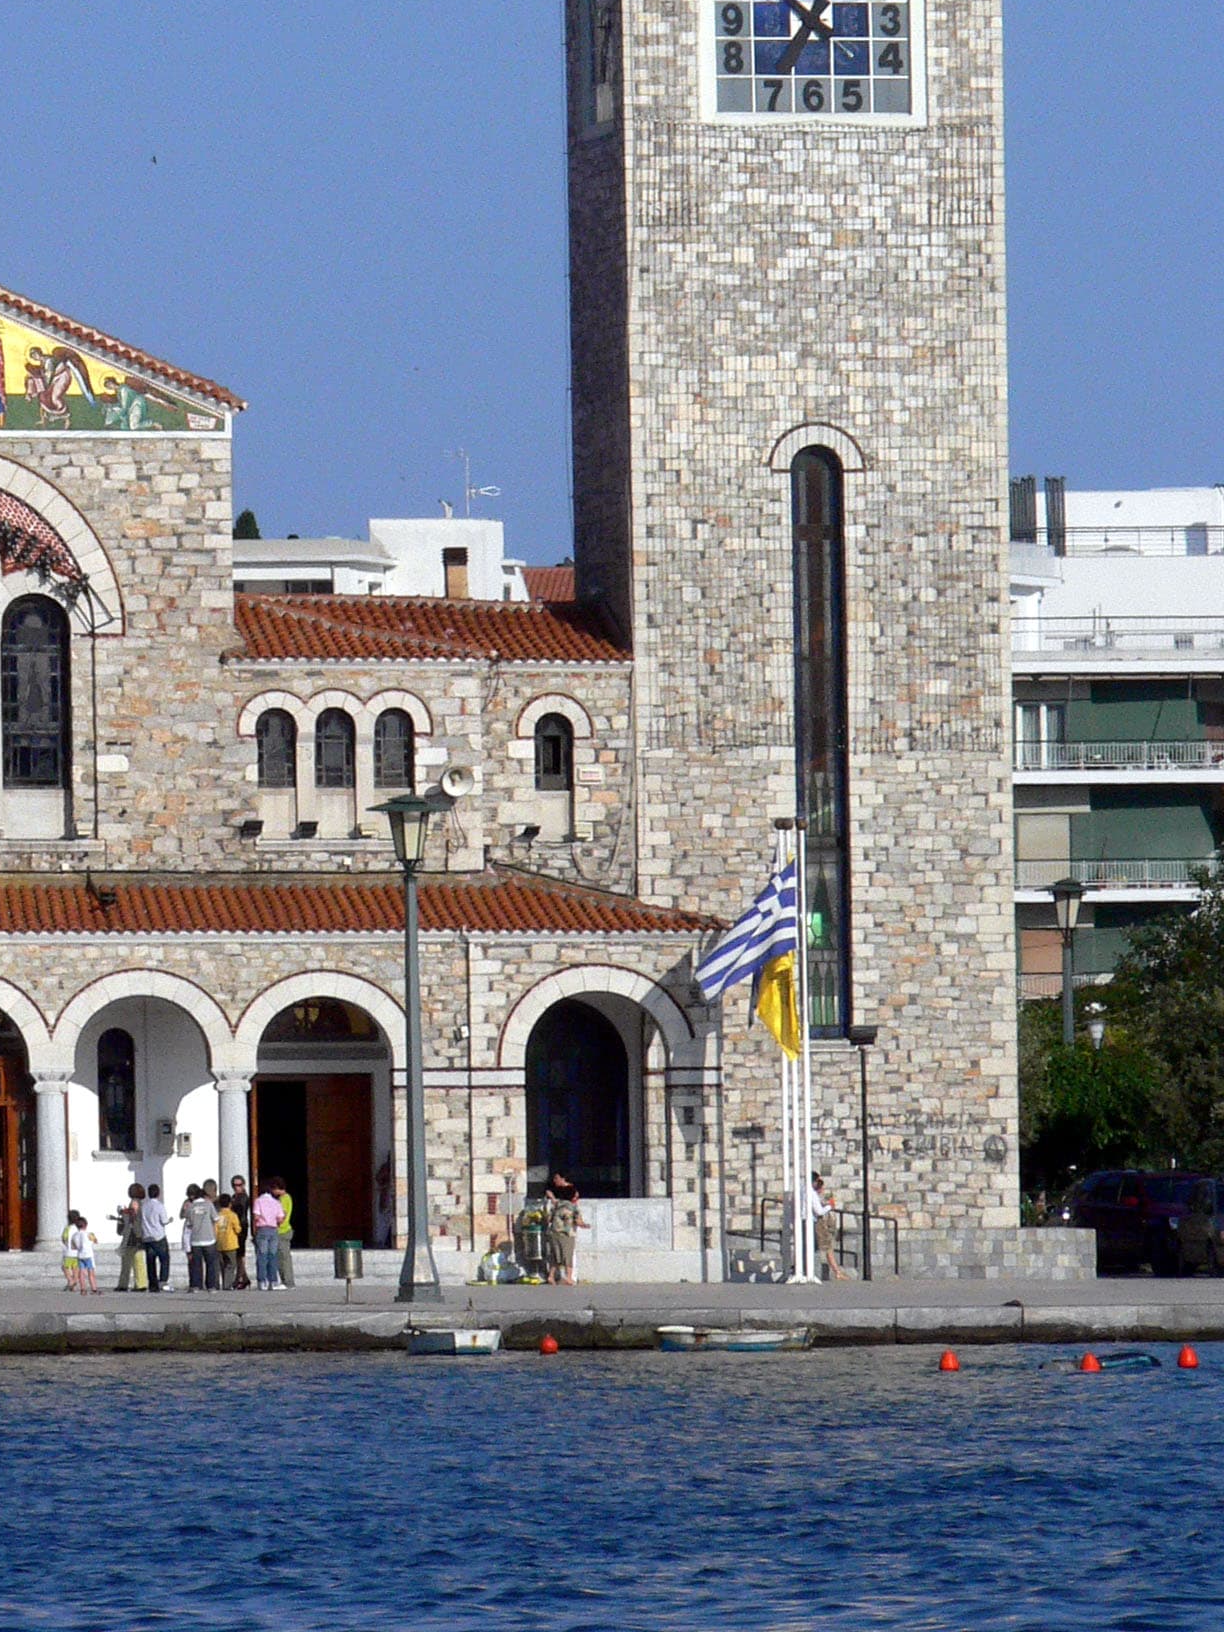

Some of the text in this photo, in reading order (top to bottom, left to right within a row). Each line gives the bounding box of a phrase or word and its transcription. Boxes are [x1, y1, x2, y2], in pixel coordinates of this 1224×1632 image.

[722, 3, 743, 36] 9
[880, 4, 900, 36] 3
[723, 41, 744, 74] 8
[878, 43, 902, 74] 4
[764, 80, 783, 111] 7
[803, 80, 824, 111] 6
[842, 80, 863, 111] 5
